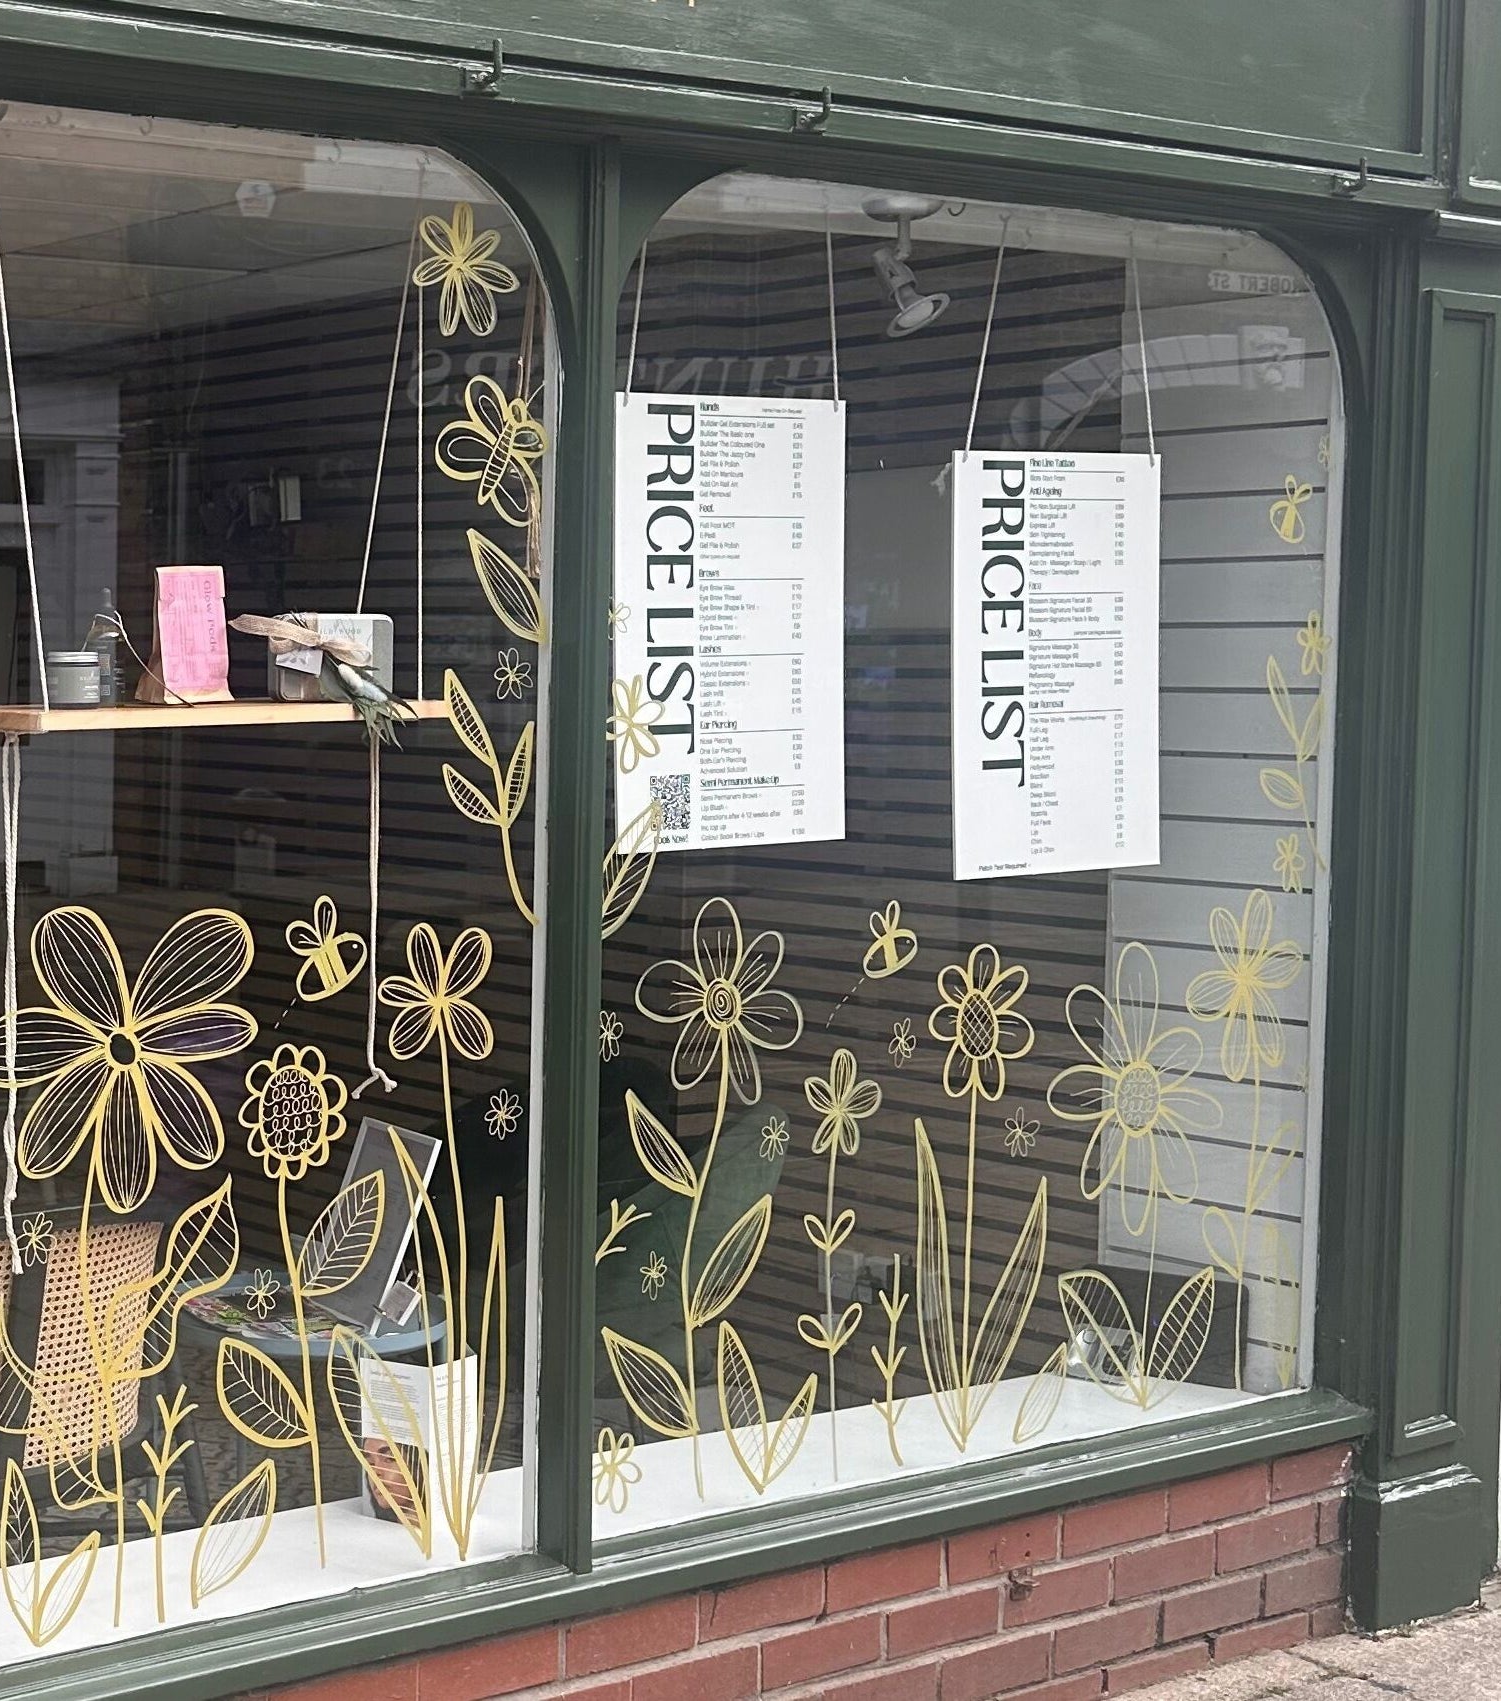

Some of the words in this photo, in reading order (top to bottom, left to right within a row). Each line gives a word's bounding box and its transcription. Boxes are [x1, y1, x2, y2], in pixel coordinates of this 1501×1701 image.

[646, 403, 695, 591] PRICE
[981, 460, 1025, 634] PRICE
[646, 607, 695, 755] LIST
[981, 650, 1025, 788] LIST
